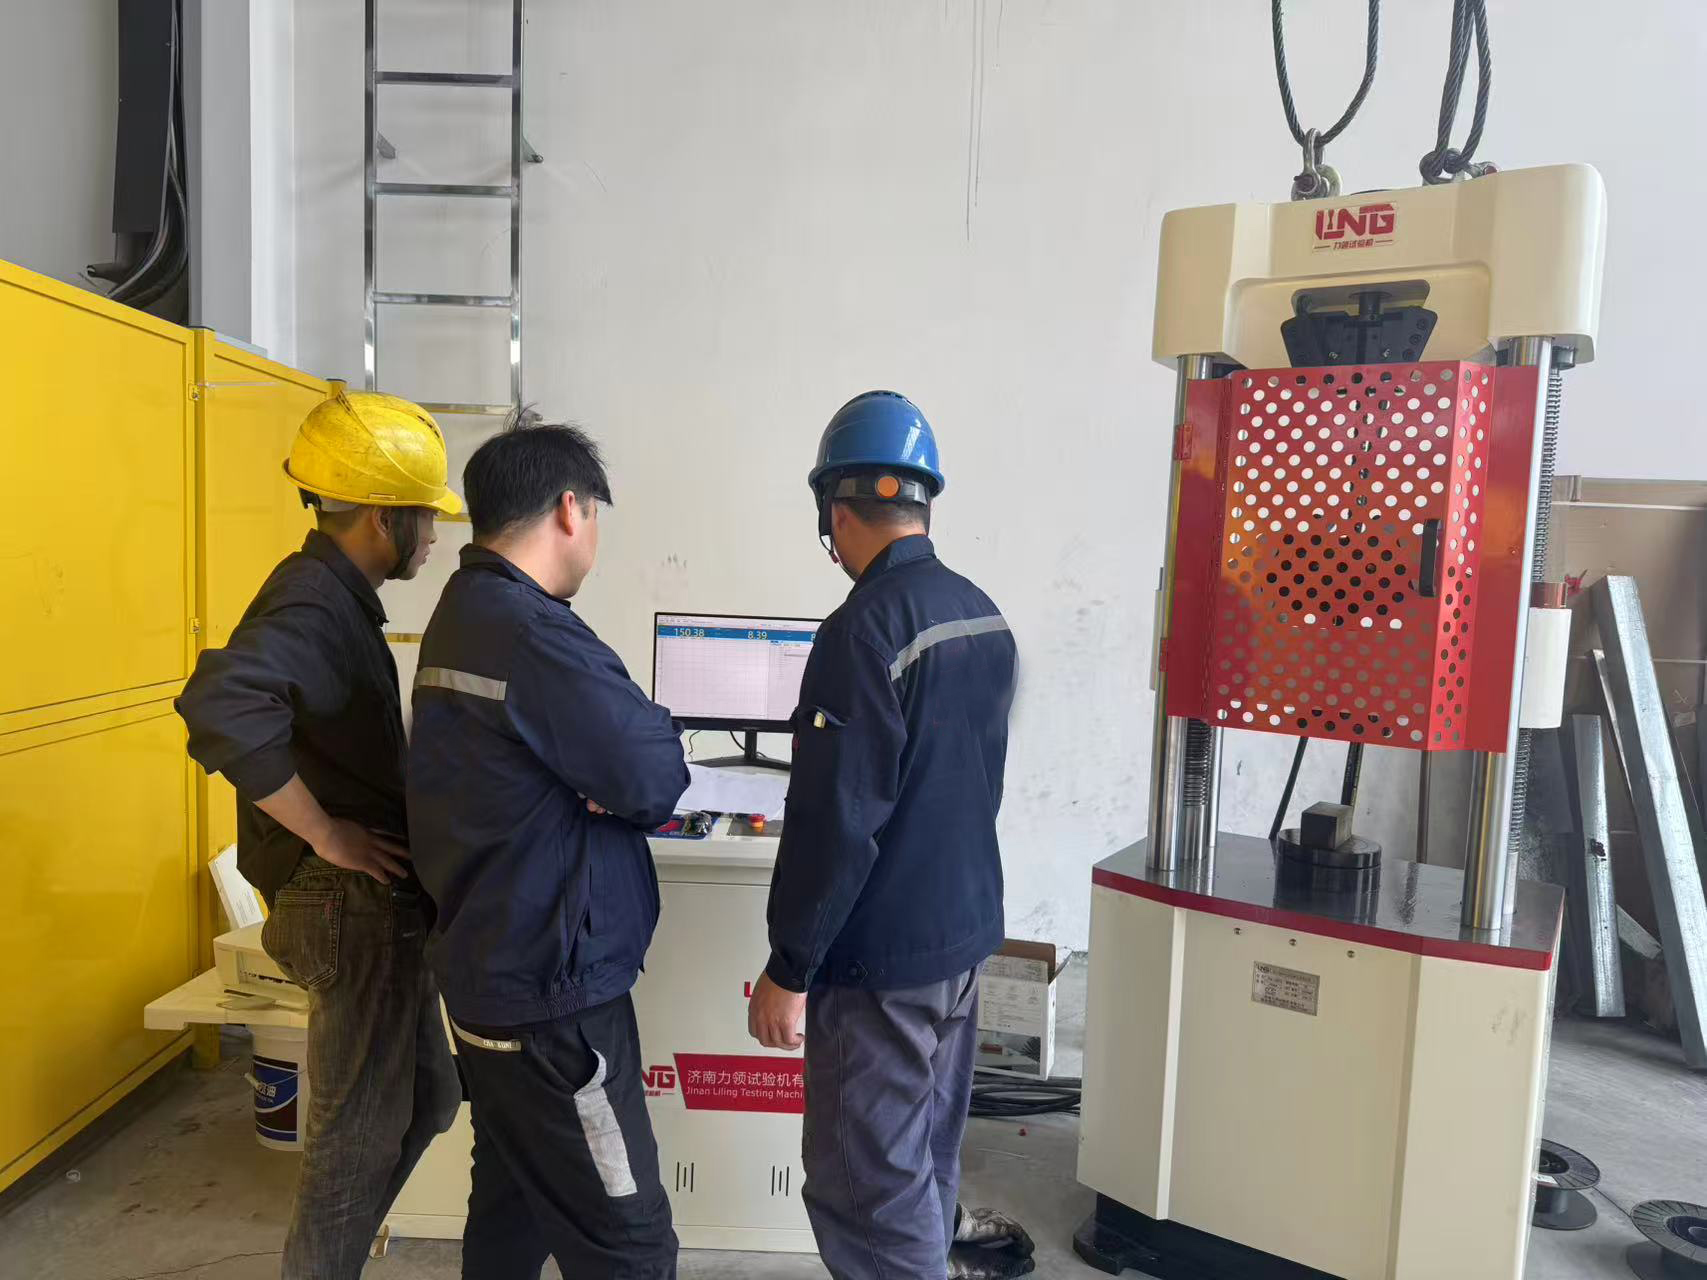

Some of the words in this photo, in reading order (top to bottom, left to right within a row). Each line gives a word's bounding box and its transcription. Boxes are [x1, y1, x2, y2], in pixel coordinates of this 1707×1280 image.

[674, 628, 705, 637] 150.38
[641, 1065, 676, 1089] NG
[687, 1069, 804, 1088] 济南力领试验机有
[686, 1086, 710, 1095] Jinan
[713, 1087, 738, 1098] Liling
[741, 1088, 774, 1100] Testing
[776, 1089, 804, 1099] Machi
